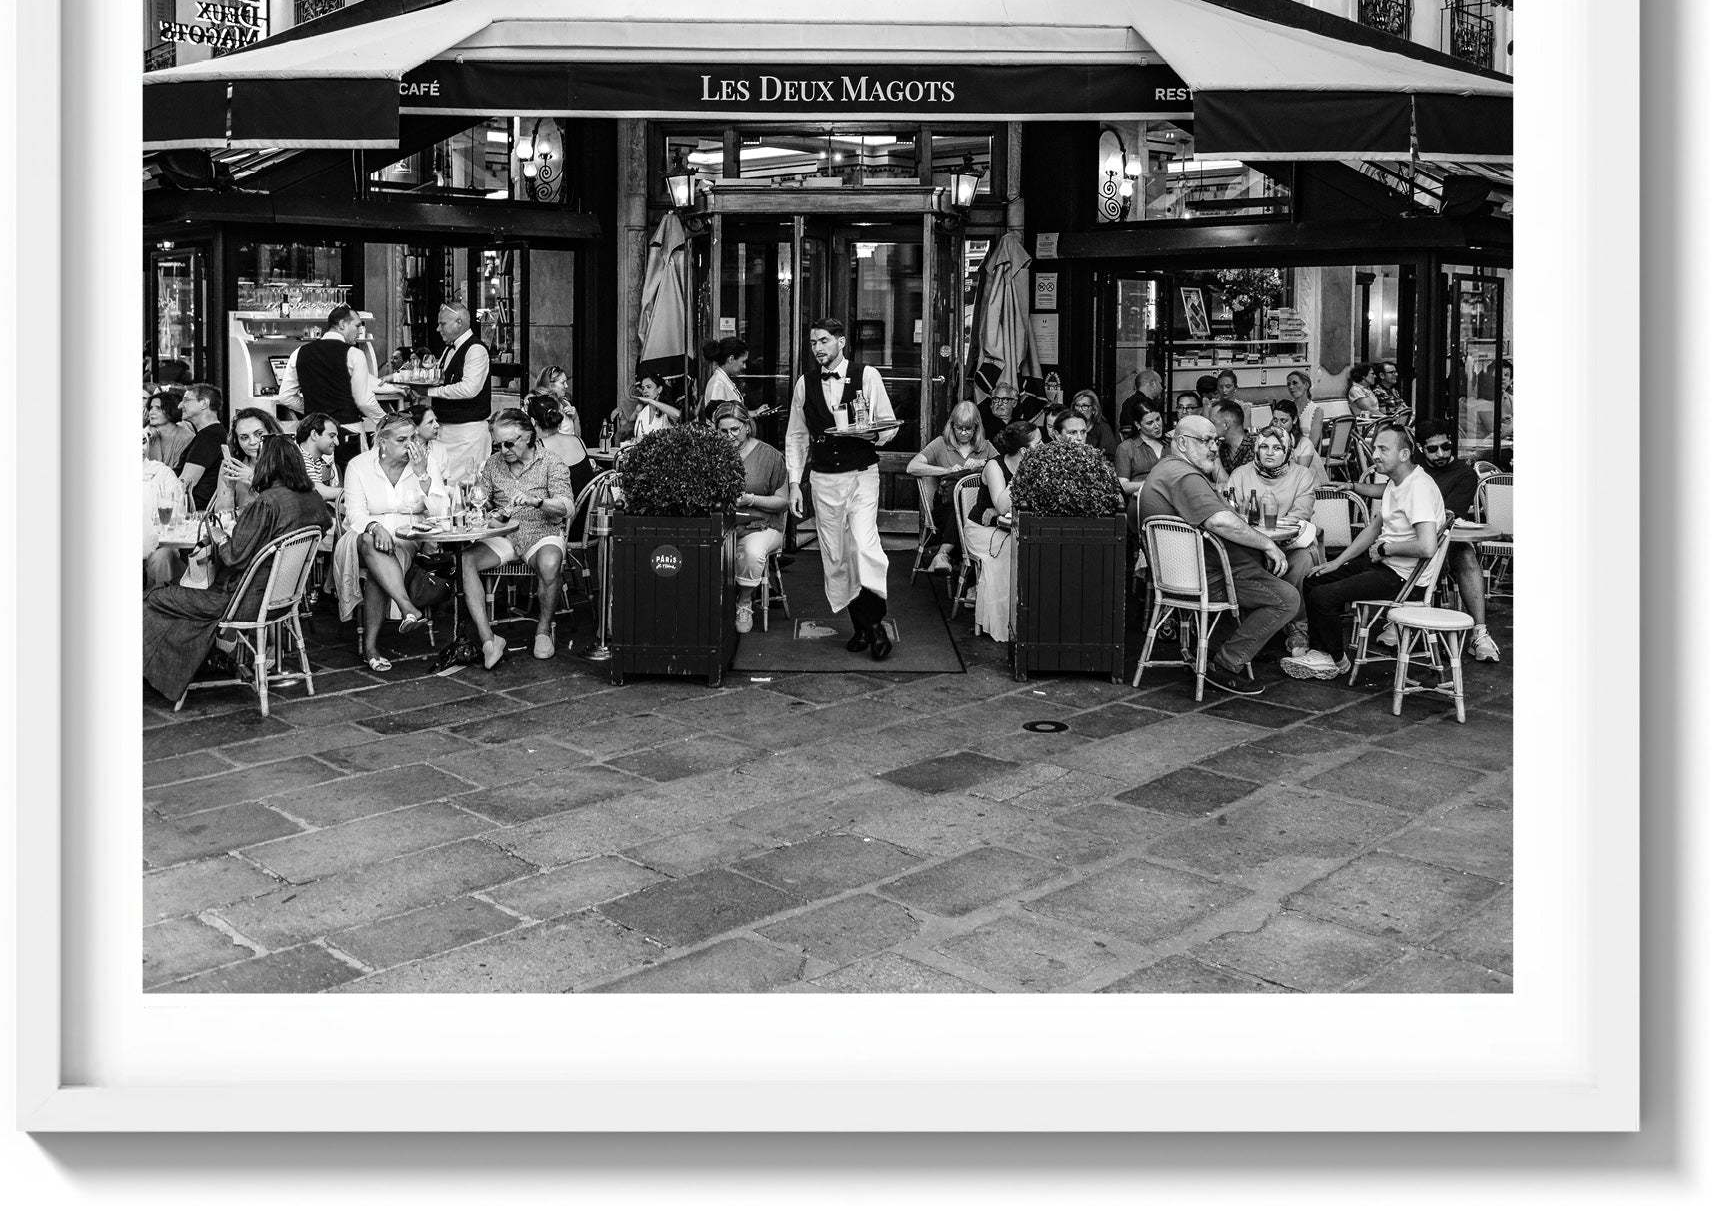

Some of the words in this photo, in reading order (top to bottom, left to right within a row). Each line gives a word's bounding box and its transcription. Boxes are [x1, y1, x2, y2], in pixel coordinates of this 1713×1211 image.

[399, 79, 440, 96] CAFÉ
[701, 75, 750, 102] LES
[759, 75, 835, 102] DEUX
[840, 76, 955, 102] MAGOTS
